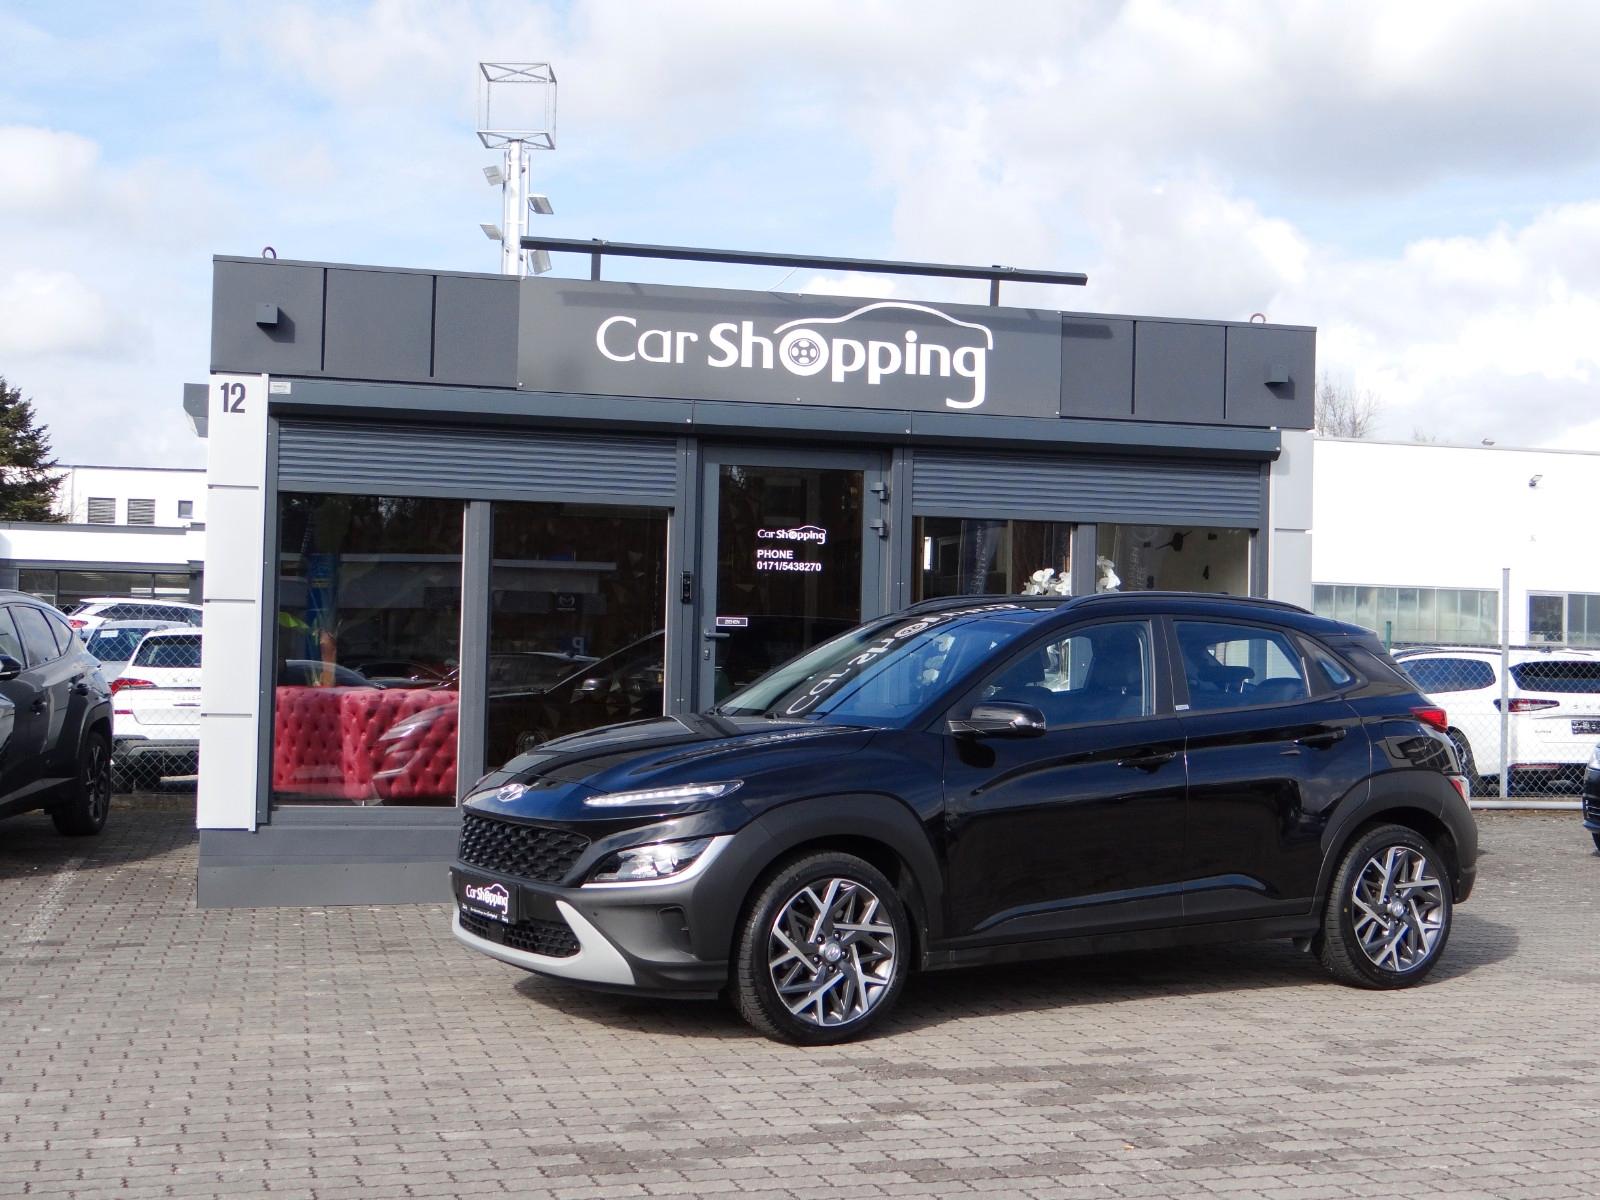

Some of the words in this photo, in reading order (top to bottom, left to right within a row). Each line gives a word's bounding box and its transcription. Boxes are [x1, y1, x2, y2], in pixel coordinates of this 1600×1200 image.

[596, 316, 699, 364] Car
[707, 318, 988, 410] Shopping
[220, 382, 246, 414] 12
[757, 529, 775, 539] Car
[757, 549, 794, 560] PHONE
[756, 561, 822, 572] 0171/5438270
